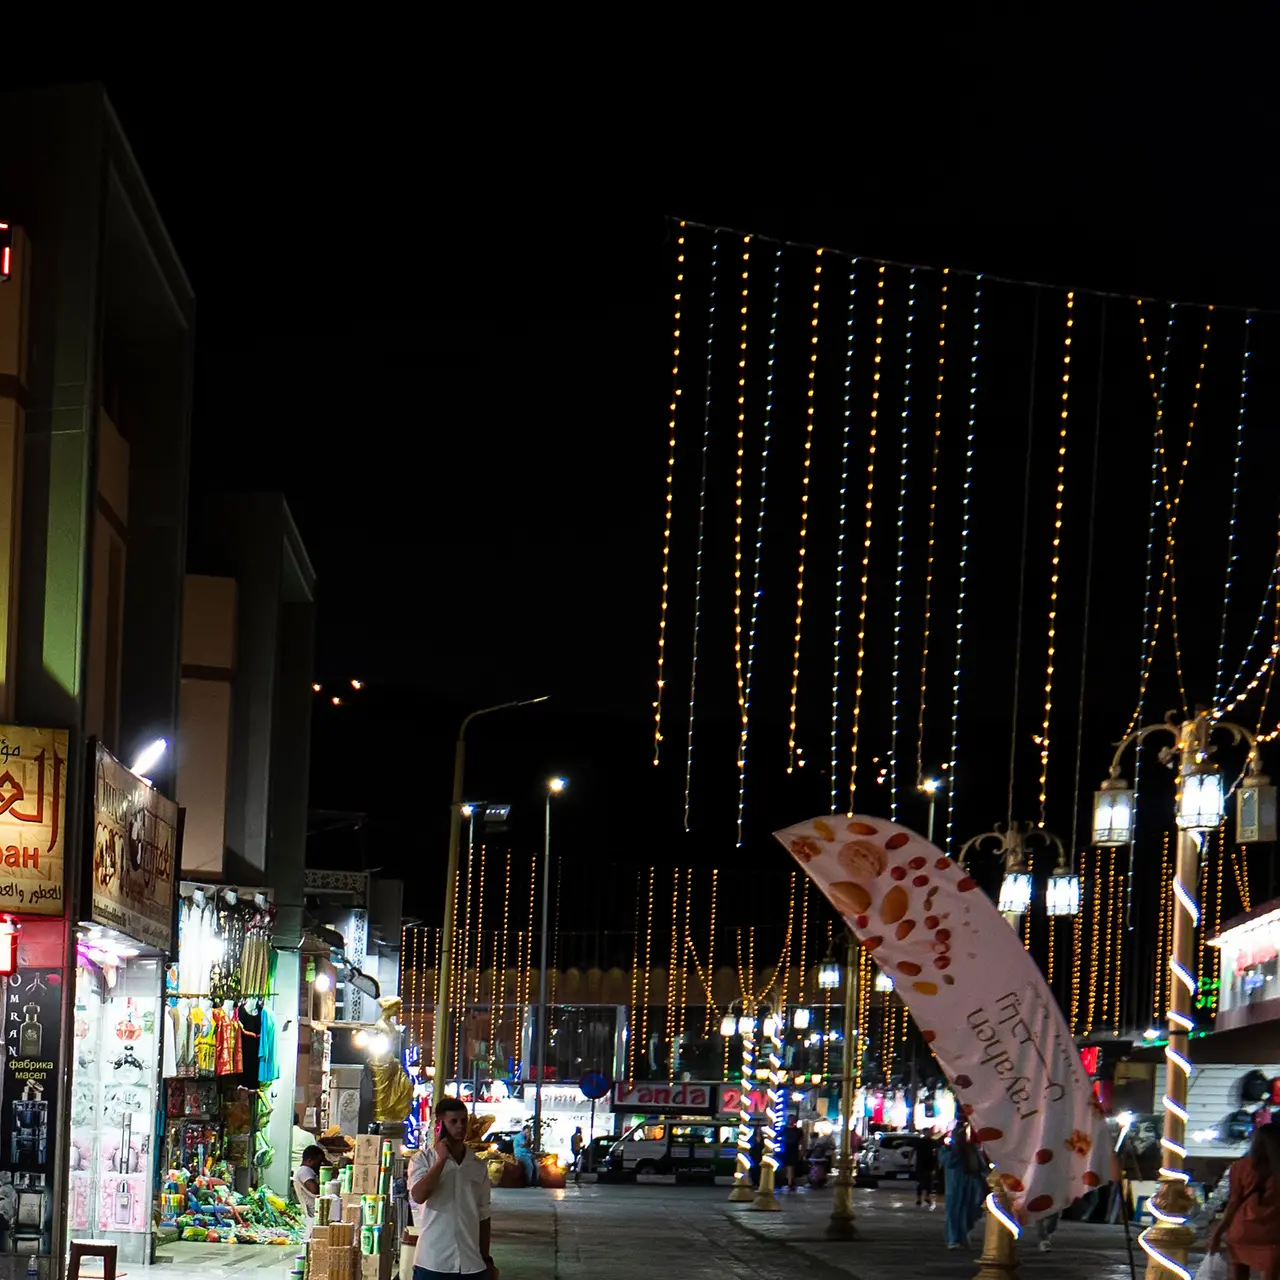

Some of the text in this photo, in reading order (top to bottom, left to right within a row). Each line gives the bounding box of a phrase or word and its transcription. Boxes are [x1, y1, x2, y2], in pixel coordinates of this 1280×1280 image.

[8, 973, 22, 1057] OMRAN
[8, 1058, 54, 1071] фабрика
[15, 1069, 47, 1080] масел
[966, 1007, 1038, 1120] rayahen
